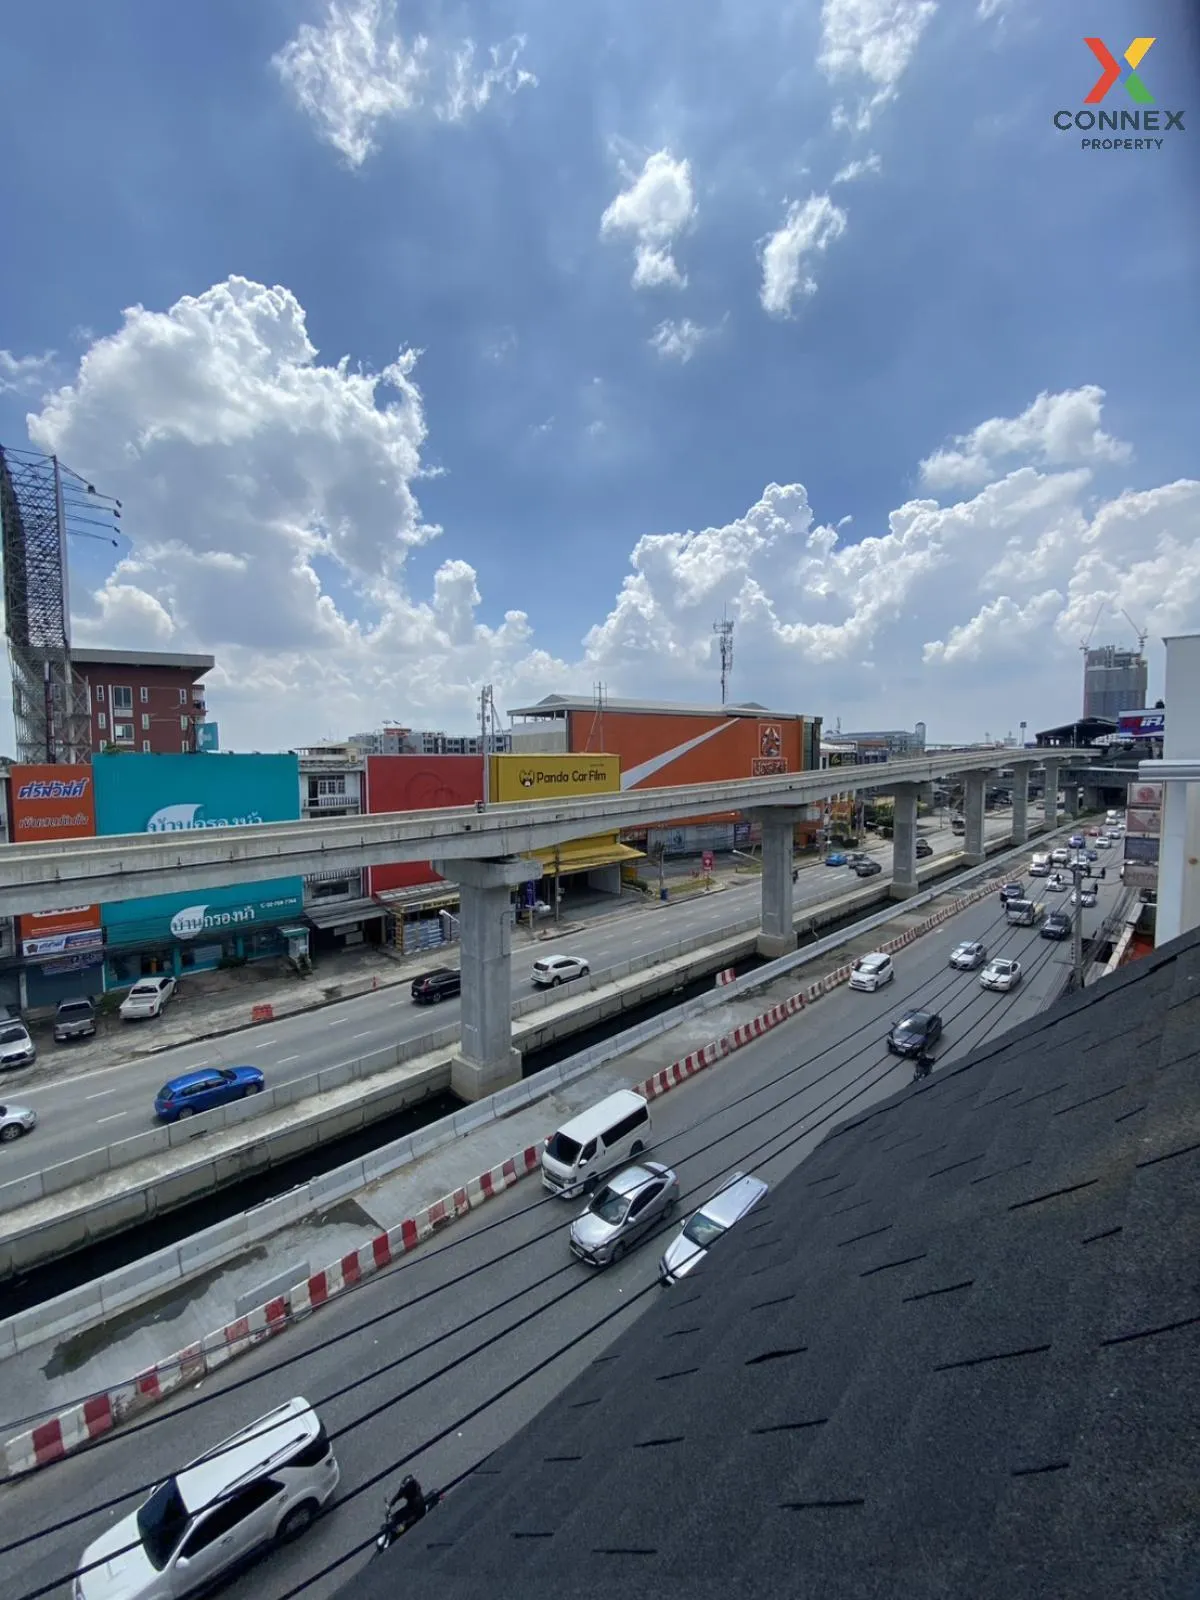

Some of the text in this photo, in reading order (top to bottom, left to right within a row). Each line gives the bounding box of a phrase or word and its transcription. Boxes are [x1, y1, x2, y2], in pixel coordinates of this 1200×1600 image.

[536, 768, 607, 784] Panda Car Film
